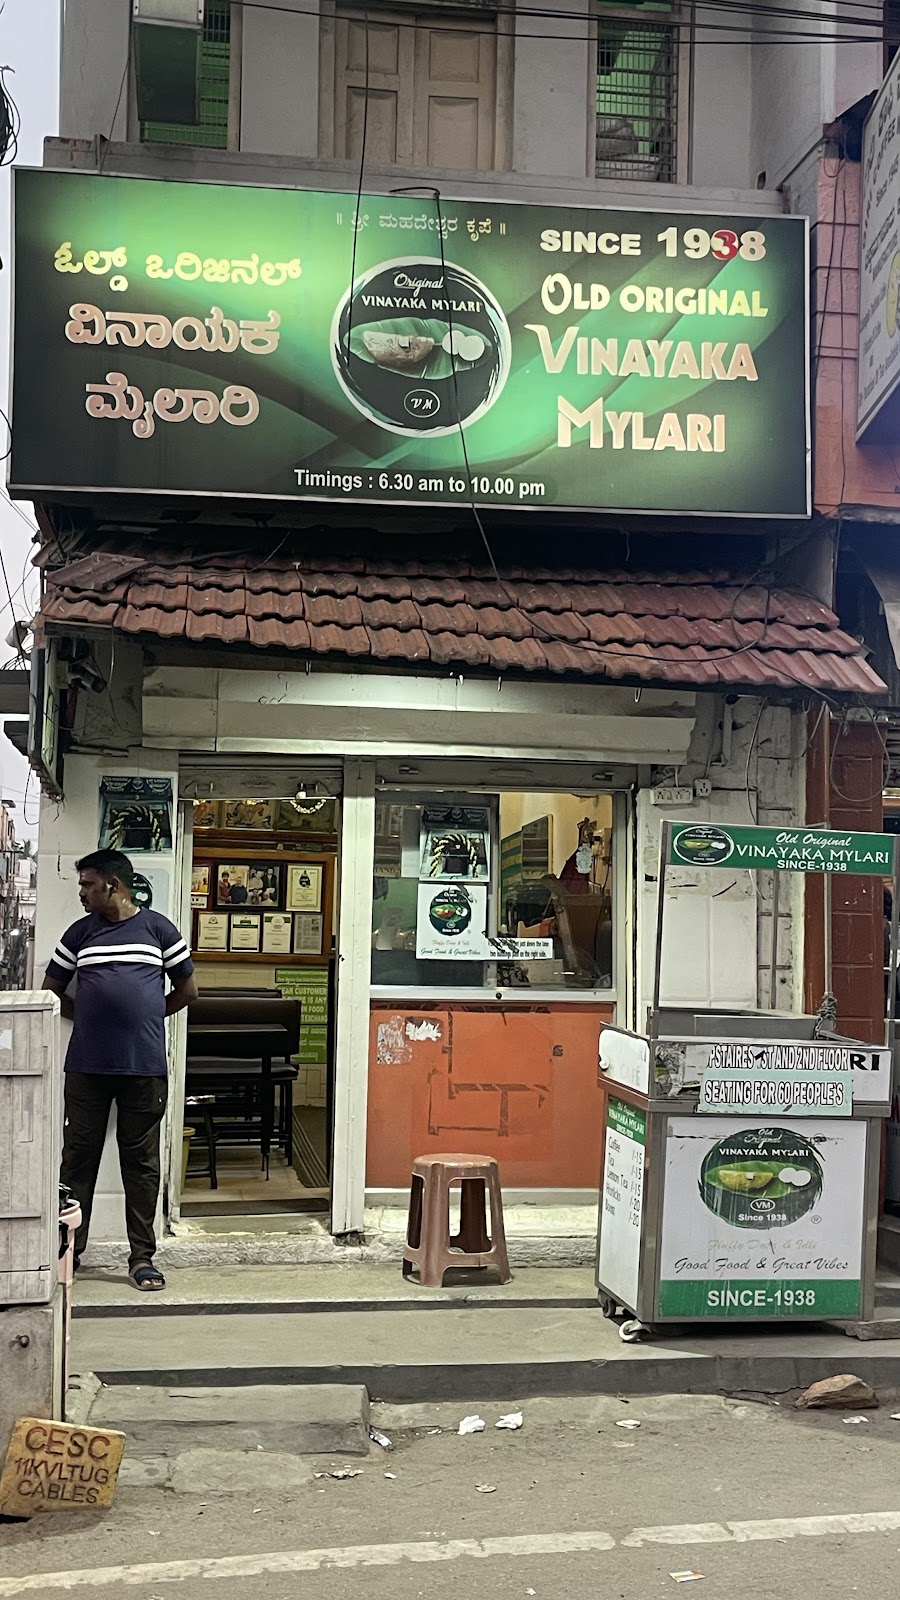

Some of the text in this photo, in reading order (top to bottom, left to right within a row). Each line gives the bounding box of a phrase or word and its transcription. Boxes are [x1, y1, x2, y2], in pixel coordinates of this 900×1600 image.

[466, 217, 491, 241] ಕೃಪೆ
[540, 227, 766, 261] SINCE 1938
[54, 241, 128, 292] ಓಲ್ಡ್
[394, 272, 444, 297] Original
[361, 295, 482, 312] VINAYAKA MYLARI
[619, 285, 769, 317] ORIGINAL
[65, 303, 281, 354] ವಿನಾಯಕ
[524, 324, 759, 381] VINAYAKA
[85, 371, 260, 439] ಮೈಲಾರಿ
[411, 398, 432, 410] VM
[557, 395, 726, 452] MYLARI
[294, 469, 363, 491] Timings
[378, 473, 413, 490] 6.30
[418, 476, 444, 492] am
[449, 477, 466, 493] to
[470, 476, 514, 495] 10.00
[519, 481, 545, 499] pm
[775, 831, 852, 848] Old Original
[736, 844, 889, 864] VINAYAKA MYLARI
[777, 859, 847, 871] SINCE-1938
[282, 987, 294, 995] EAR
[706, 1045, 850, 1071] PSTAIRES ST AND 2ND FLOOR
[704, 1080, 844, 1106] SEATING FOR 60 PEOPLE'S
[719, 1148, 809, 1157] VINAYAKA MYLARI
[744, 1134, 783, 1148] Original
[755, 1201, 771, 1209] VM
[738, 1213, 787, 1222] Since 1938
[674, 1257, 849, 1273] Good Food & Great Vibes
[707, 1289, 816, 1307] SINCE-1938
[25, 1426, 110, 1460] CESC
[17, 1480, 100, 1504] CABLES
